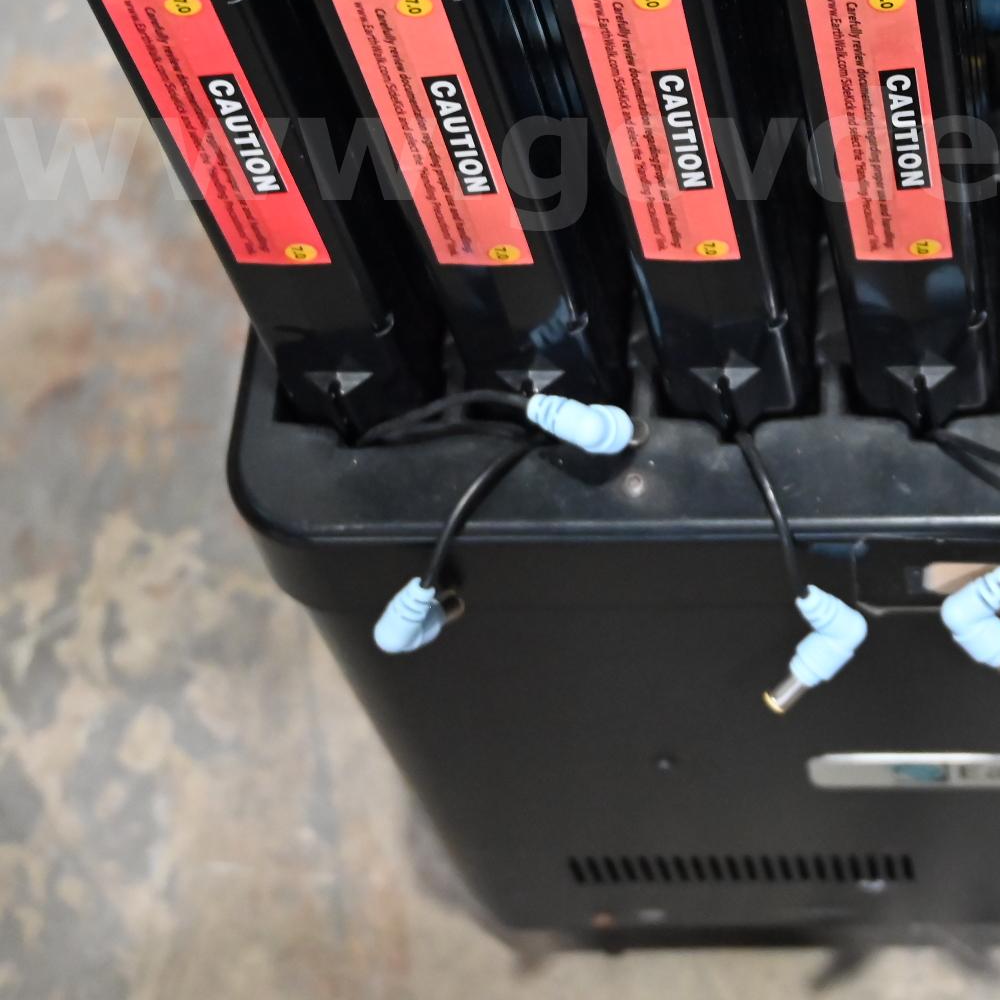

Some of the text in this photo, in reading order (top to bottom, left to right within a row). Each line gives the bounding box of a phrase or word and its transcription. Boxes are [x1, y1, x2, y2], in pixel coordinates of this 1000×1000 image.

[145, 7, 168, 44] Carefully
[846, 2, 862, 38] Carefully
[853, 40, 865, 67] review
[375, 8, 396, 45] Carefully
[389, 46, 405, 72] review
[400, 74, 427, 131] documentation
[422, 132, 441, 168] regarding
[612, 1, 631, 39] Carefully
[622, 40, 635, 66] review
[629, 68, 650, 126] documentation
[643, 127, 661, 164] regarding
[652, 164, 666, 188] proper
[857, 69, 874, 126] documentation
[622, 111, 633, 125] and
[660, 76, 705, 187] CAUTION
[846, 112, 858, 126] and
[887, 75, 924, 186] CAUTION
[210, 80, 279, 191] CAUTION
[398, 117, 410, 131] and
[404, 132, 419, 153] select
[432, 81, 489, 192] CAUTION
[626, 126, 640, 147] select
[849, 127, 861, 148] select
[865, 126, 881, 163] regarding
[634, 148, 642, 161] the
[853, 149, 864, 161] the
[292, 246, 307, 259] 7.0
[495, 247, 509, 261] 7.0
[704, 242, 717, 255] 7.0
[917, 241, 929, 255] 7.0
